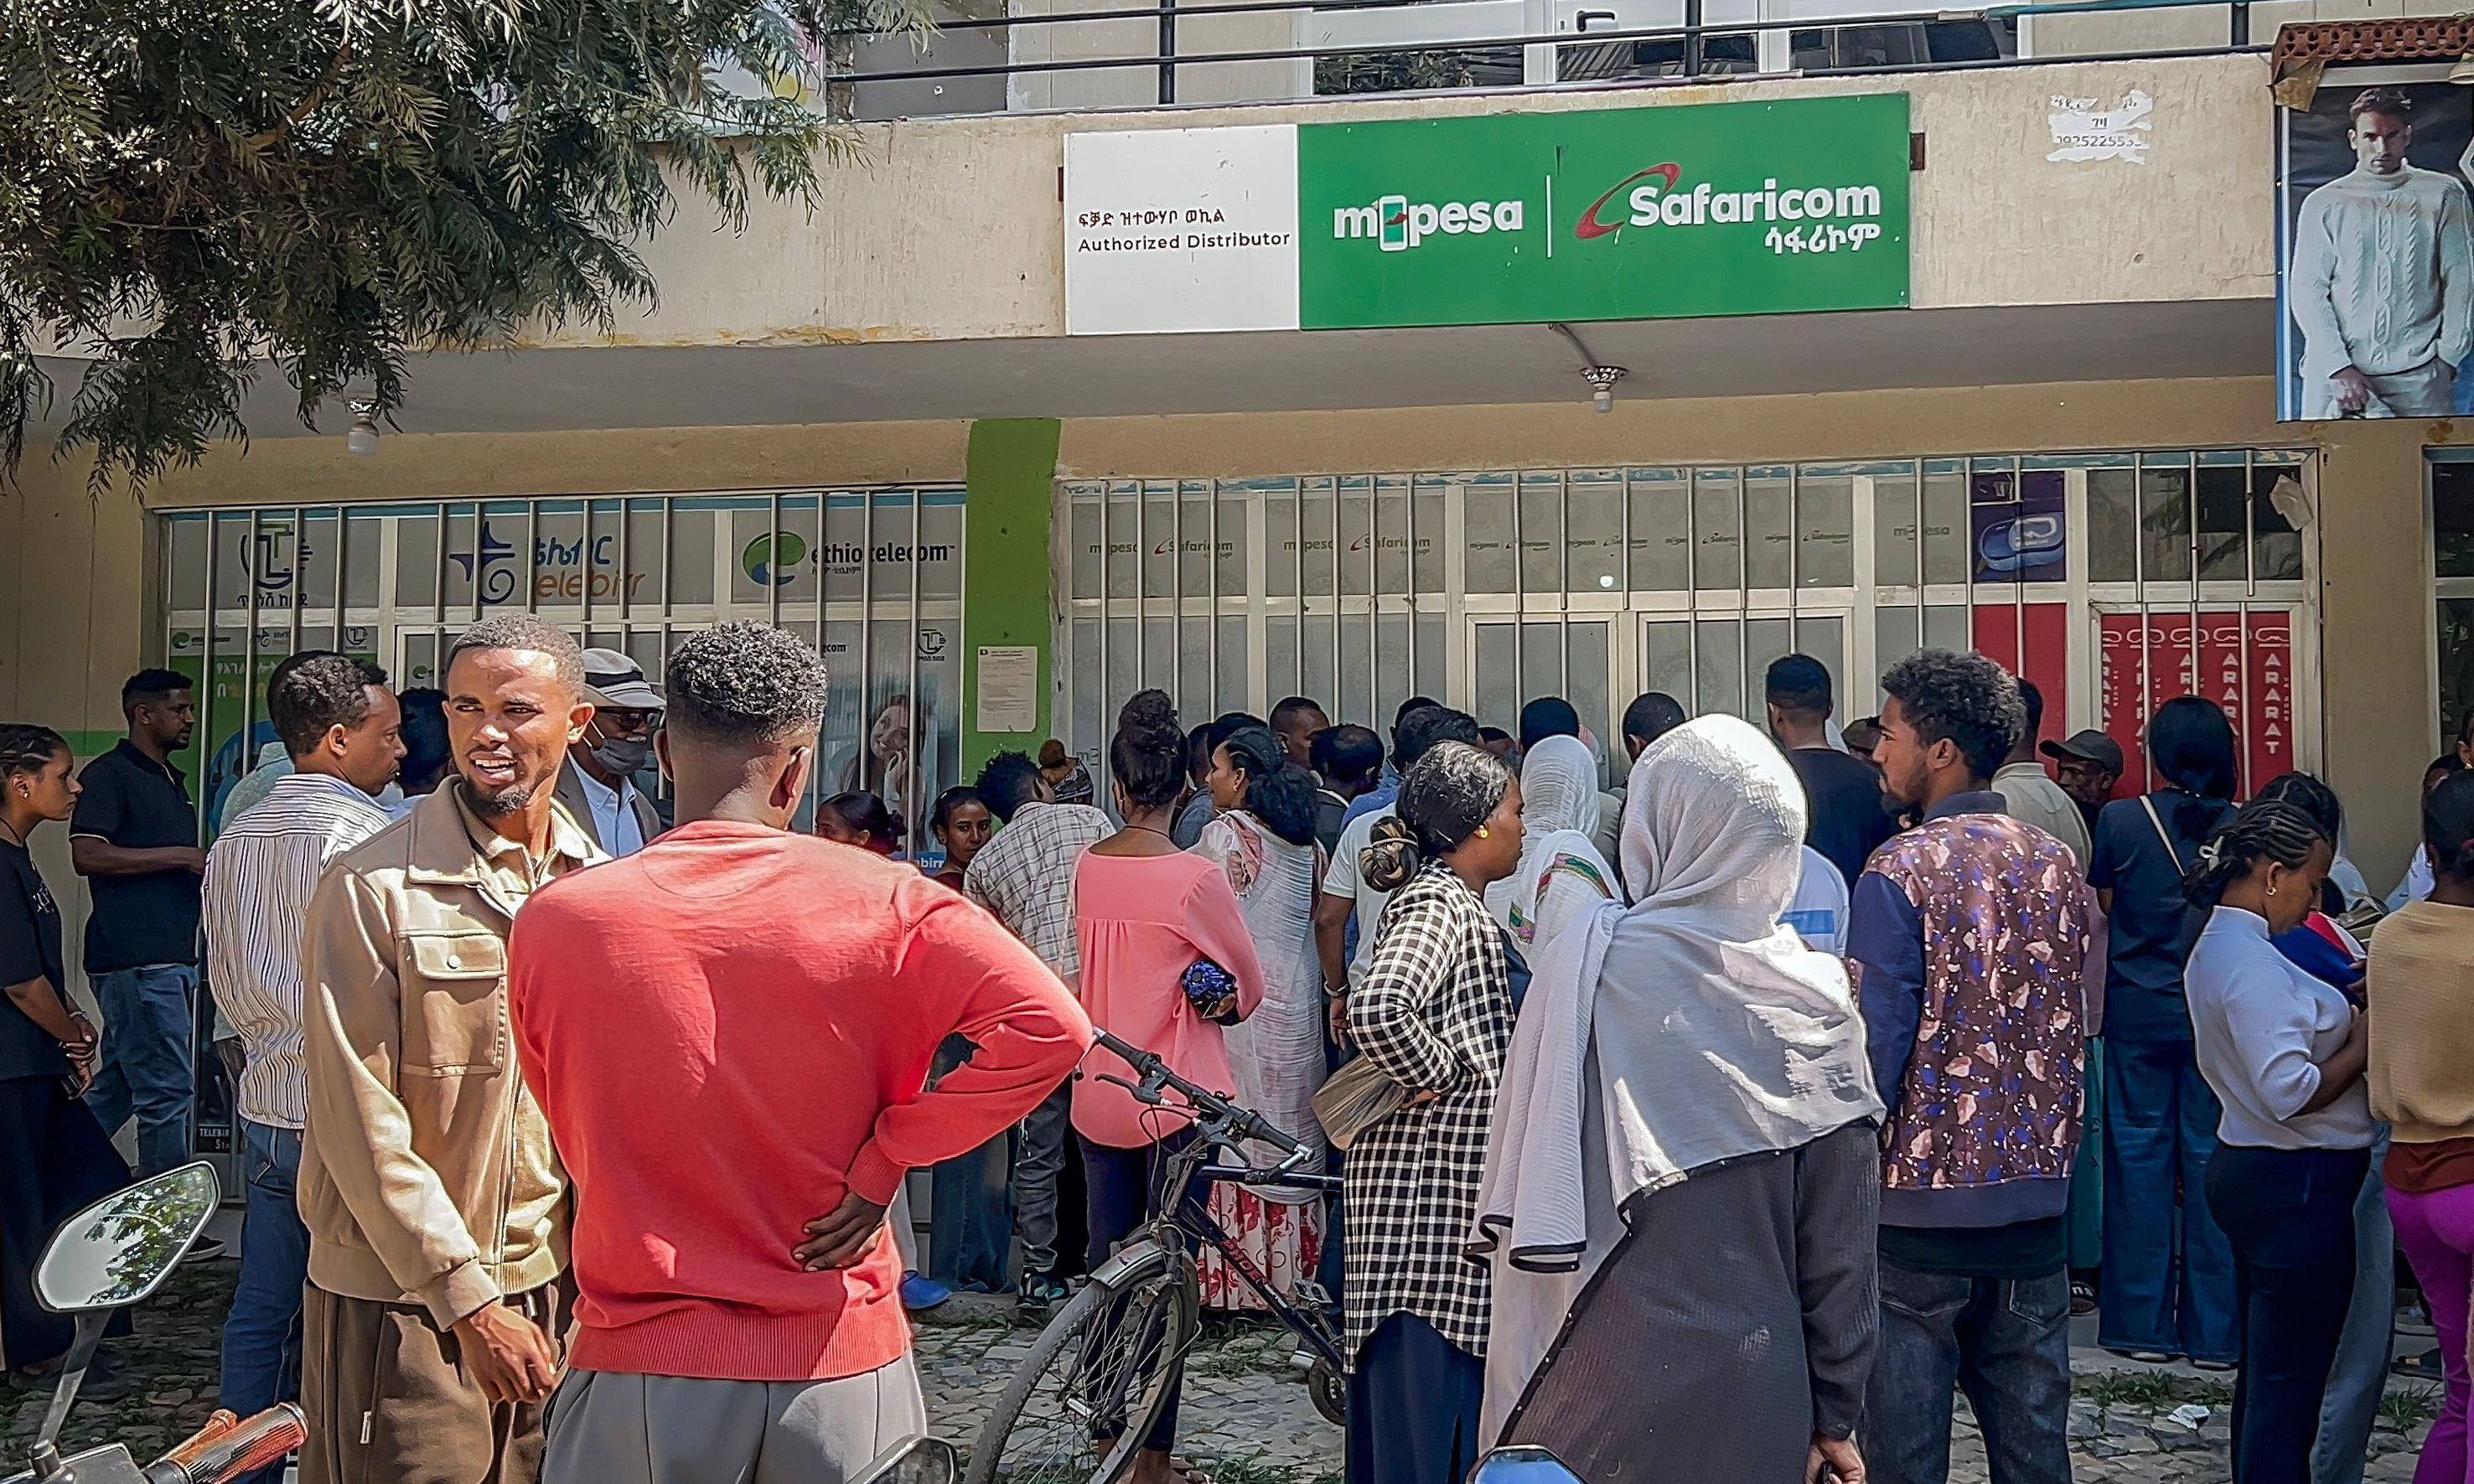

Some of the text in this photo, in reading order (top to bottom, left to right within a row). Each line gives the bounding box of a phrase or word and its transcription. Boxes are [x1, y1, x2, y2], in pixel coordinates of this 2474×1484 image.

[1628, 178, 1881, 227] Safaricom
[1078, 231, 1291, 252] Authorized Distributor
[1763, 222, 1881, 255] ሳፋሪኮም
[2223, 652, 2239, 737] ARAR
[2264, 652, 2282, 754] ARARAT
